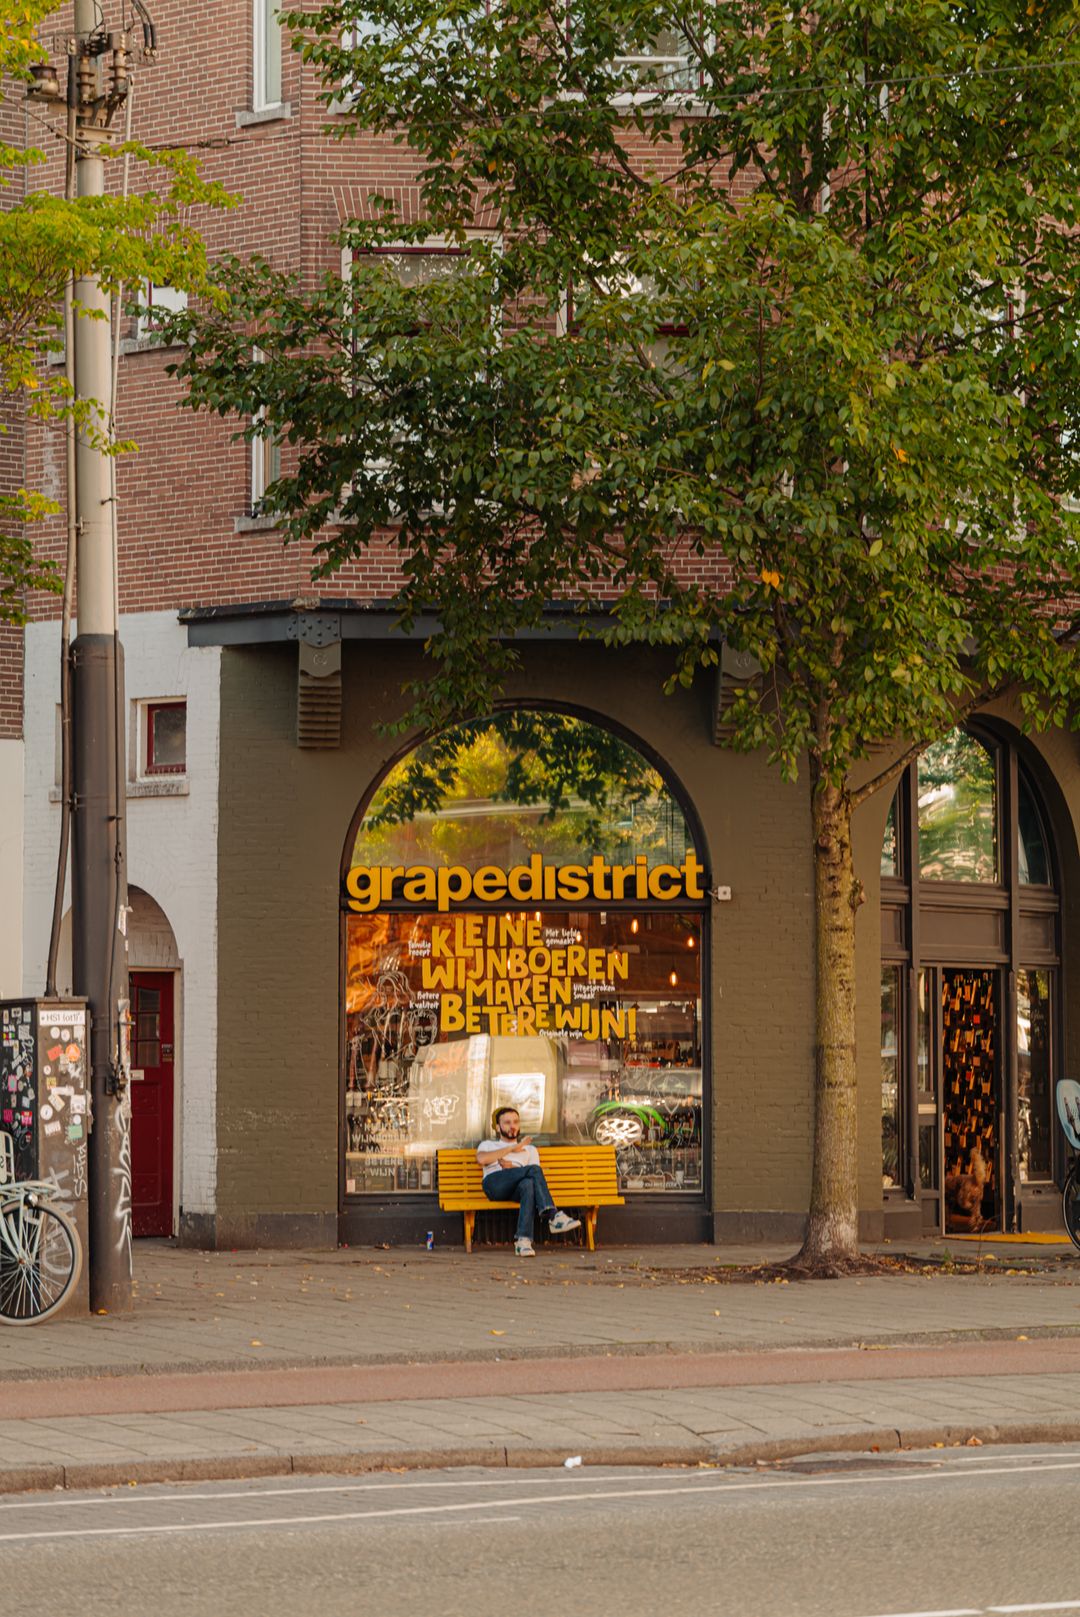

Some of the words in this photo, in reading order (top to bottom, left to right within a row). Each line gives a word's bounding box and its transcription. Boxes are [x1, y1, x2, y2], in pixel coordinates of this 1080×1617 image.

[346, 853, 704, 912] grapedistrict
[431, 914, 544, 958] KLEINE
[421, 945, 629, 990] WIJNBOEREN
[465, 975, 572, 1012] MAKEN
[440, 993, 550, 1037] BETERE
[555, 1002, 637, 1042] WIJN!
